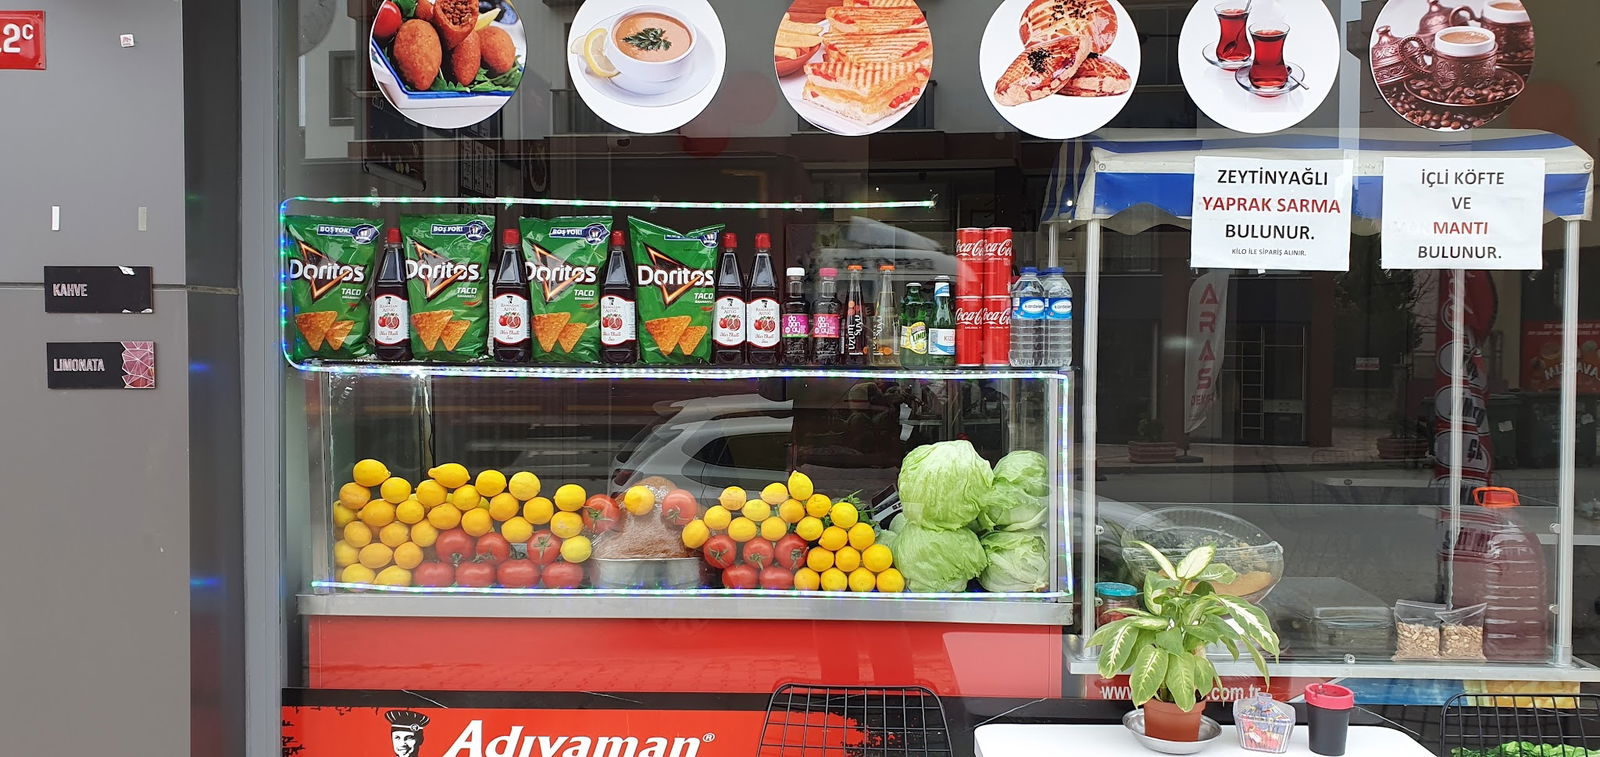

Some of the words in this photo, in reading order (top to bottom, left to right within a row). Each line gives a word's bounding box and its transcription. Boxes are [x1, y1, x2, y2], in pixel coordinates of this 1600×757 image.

[0, 23, 34, 53] 2C
[1217, 167, 1328, 186] ZEYTİNYAĞLI
[1421, 169, 1449, 187] İÇLİ
[1454, 169, 1505, 185] KÖFTE
[1203, 196, 1272, 212] YAPRAK
[1277, 197, 1341, 214] SARMA
[1451, 197, 1472, 210] VE
[1225, 224, 1315, 240] BULUNUR.
[1433, 221, 1489, 235] MANTI
[1418, 246, 1502, 259] BULUNUR.
[289, 259, 365, 283] Doritos
[405, 259, 480, 281] Doritos
[525, 262, 597, 283] Doritos
[637, 265, 715, 286] Doritos
[52, 283, 88, 298] KAHVE
[342, 287, 362, 296] TACO
[456, 287, 478, 295] TACO
[573, 289, 595, 297] TACO
[694, 292, 714, 300] TACO
[53, 358, 105, 373] LIMONATA
